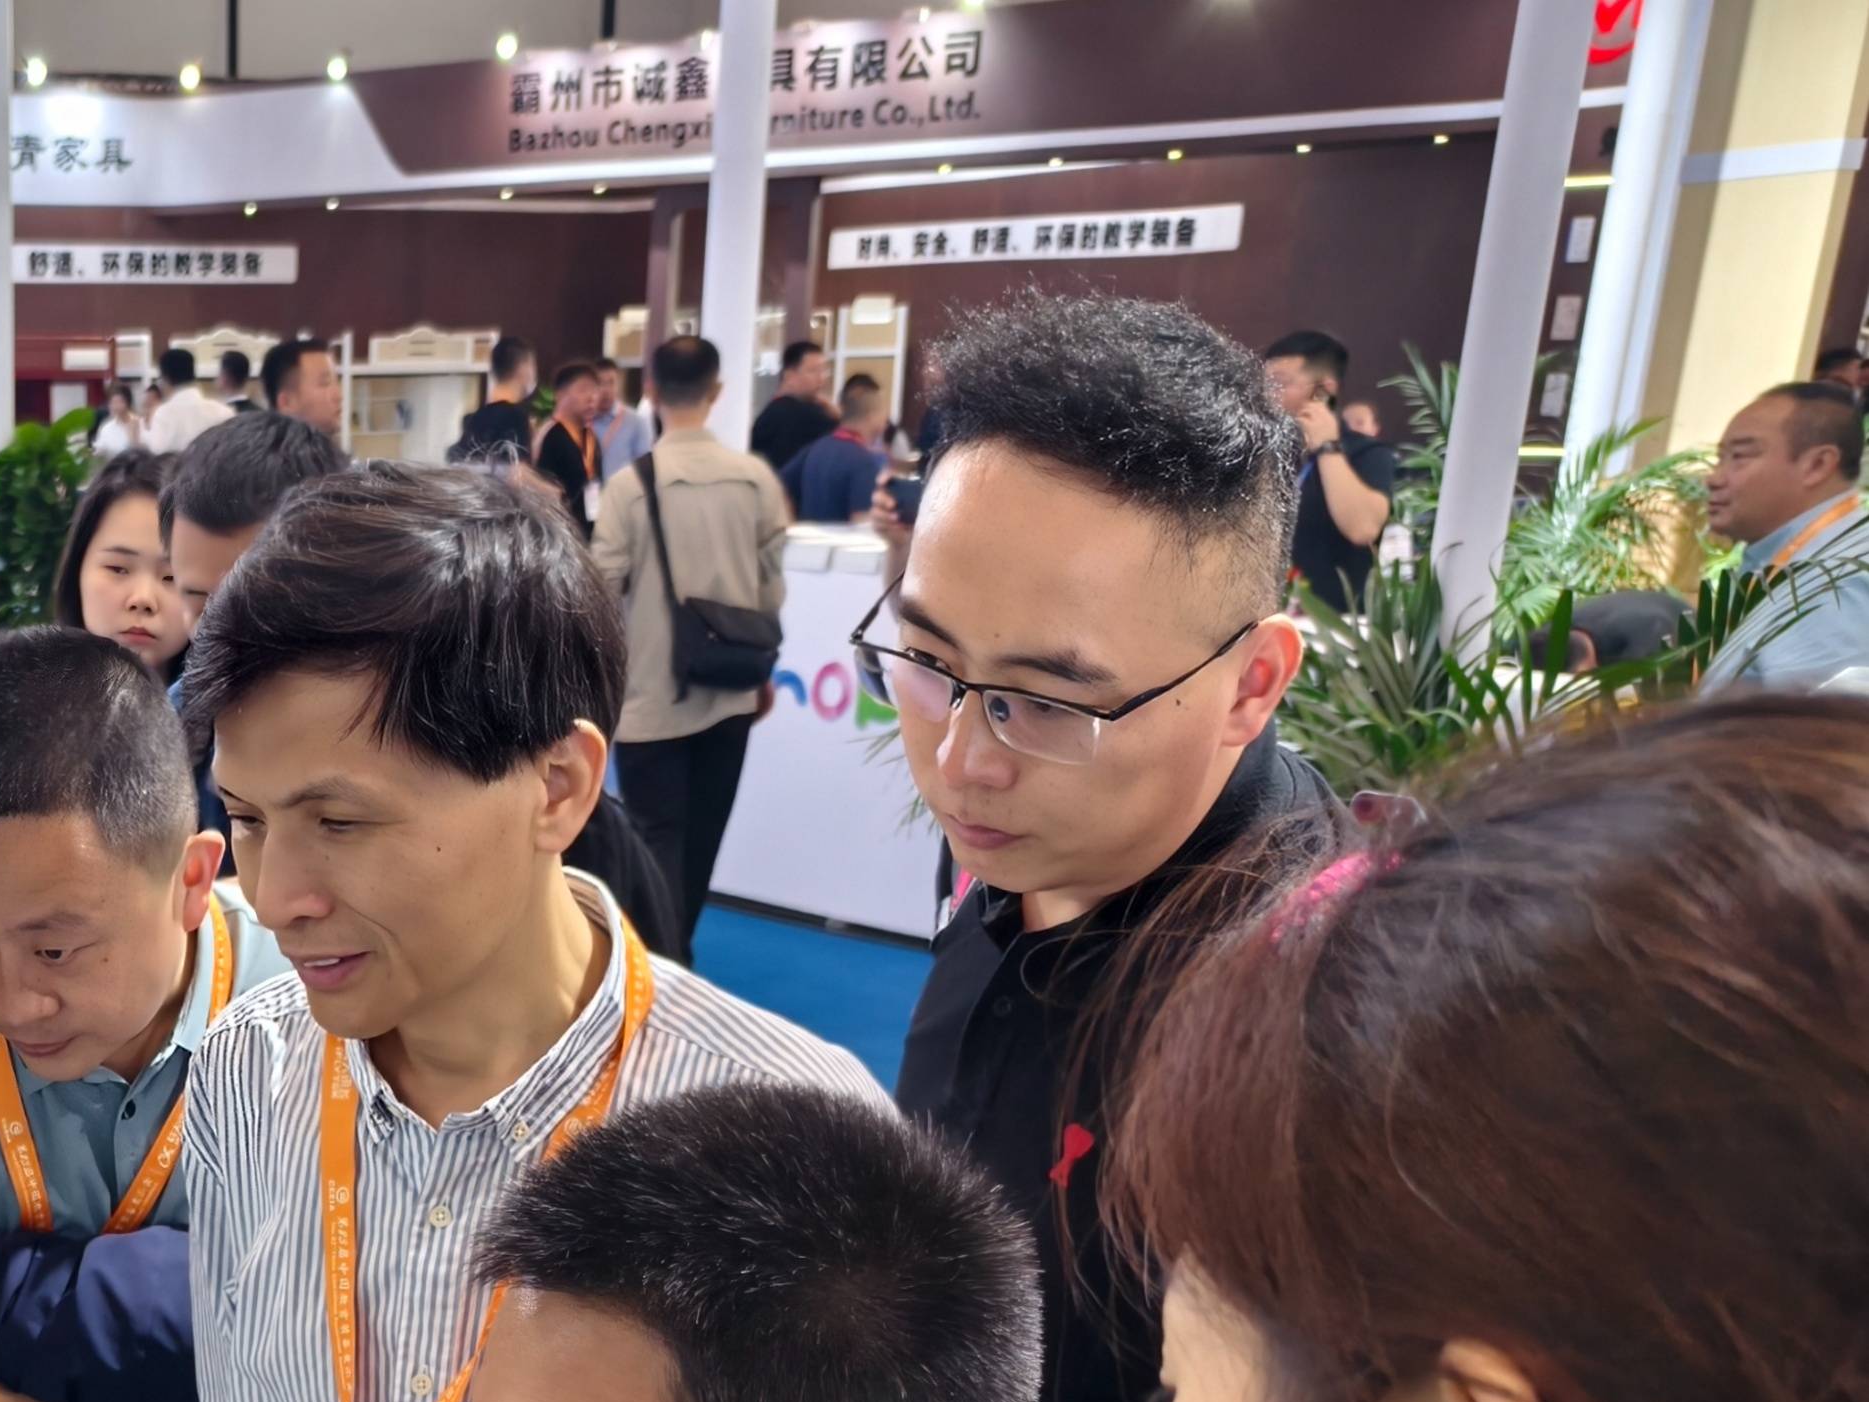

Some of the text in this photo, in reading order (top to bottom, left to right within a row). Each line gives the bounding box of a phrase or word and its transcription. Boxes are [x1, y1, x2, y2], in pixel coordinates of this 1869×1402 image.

[509, 29, 984, 115] 霸州市诚鑫具有限公司
[508, 124, 598, 153] Bazhou
[607, 112, 714, 150] Chengxi
[770, 102, 865, 135] rniture
[856, 217, 1197, 262] 时尚、安全、舒适、环保的教学装备
